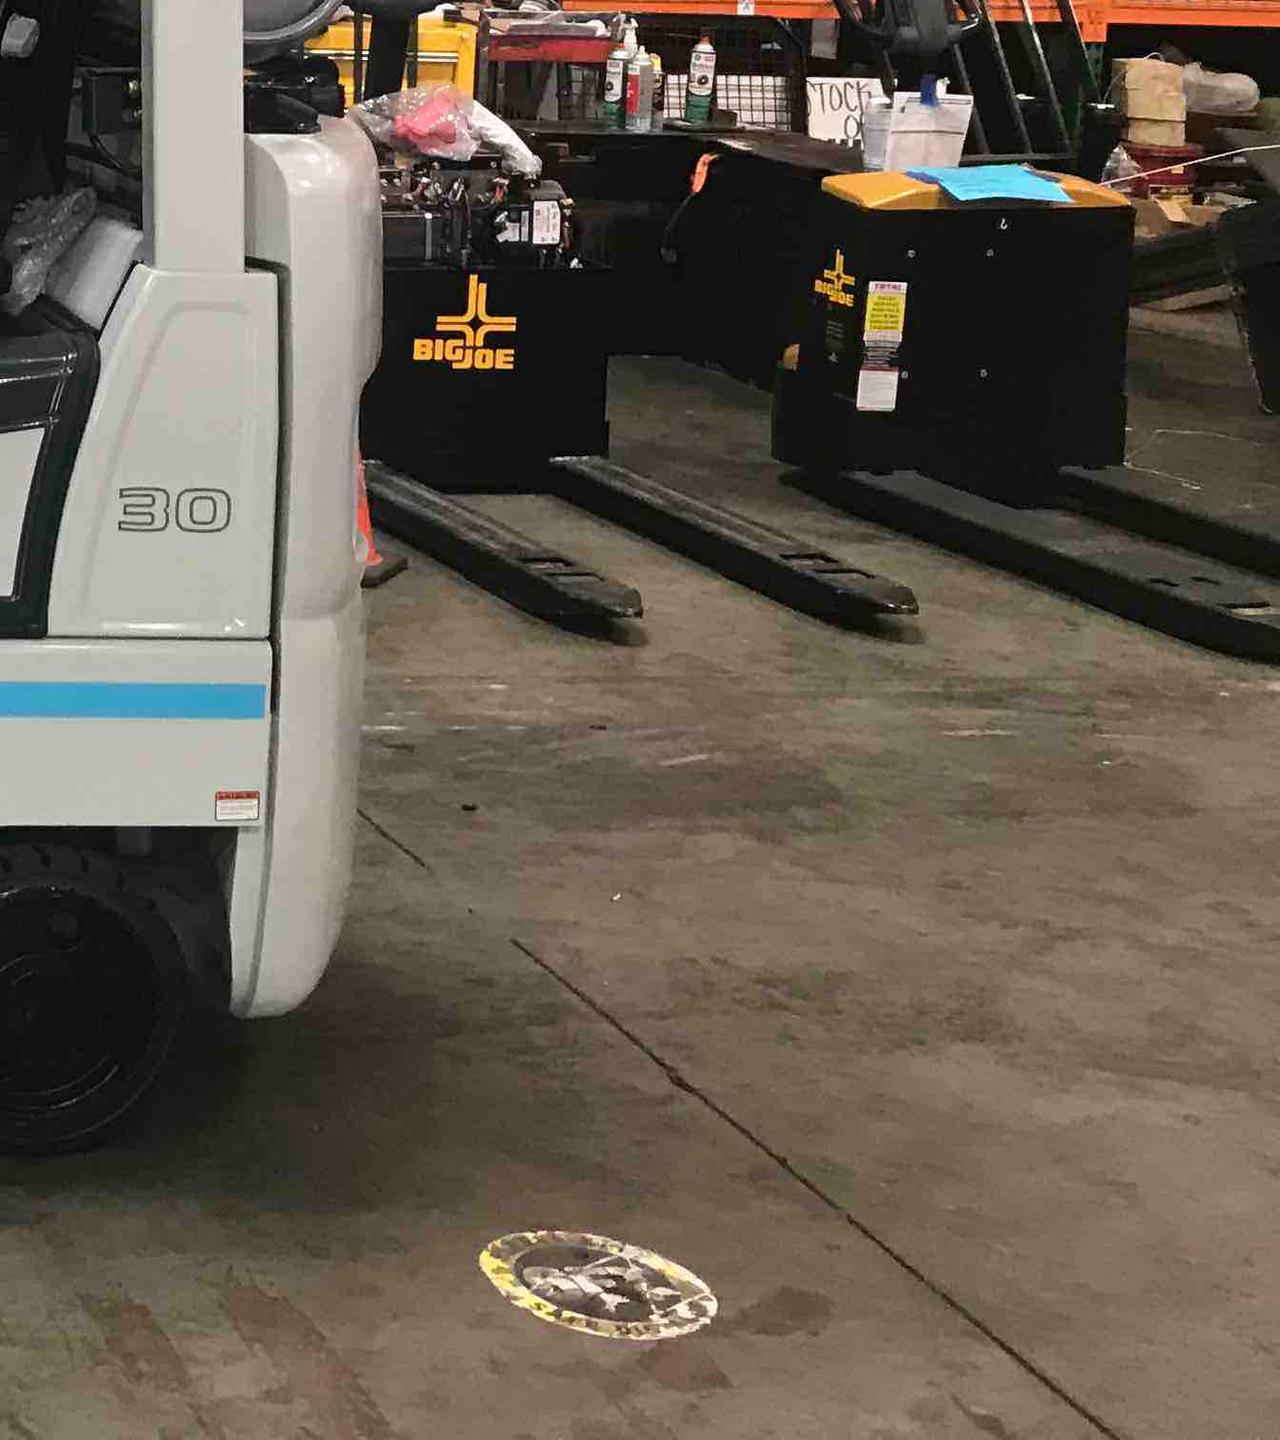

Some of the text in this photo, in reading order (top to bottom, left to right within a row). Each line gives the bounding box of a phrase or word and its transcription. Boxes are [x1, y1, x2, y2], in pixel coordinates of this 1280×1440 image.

[413, 339, 515, 369] BIG JOE
[118, 487, 231, 533] 30
